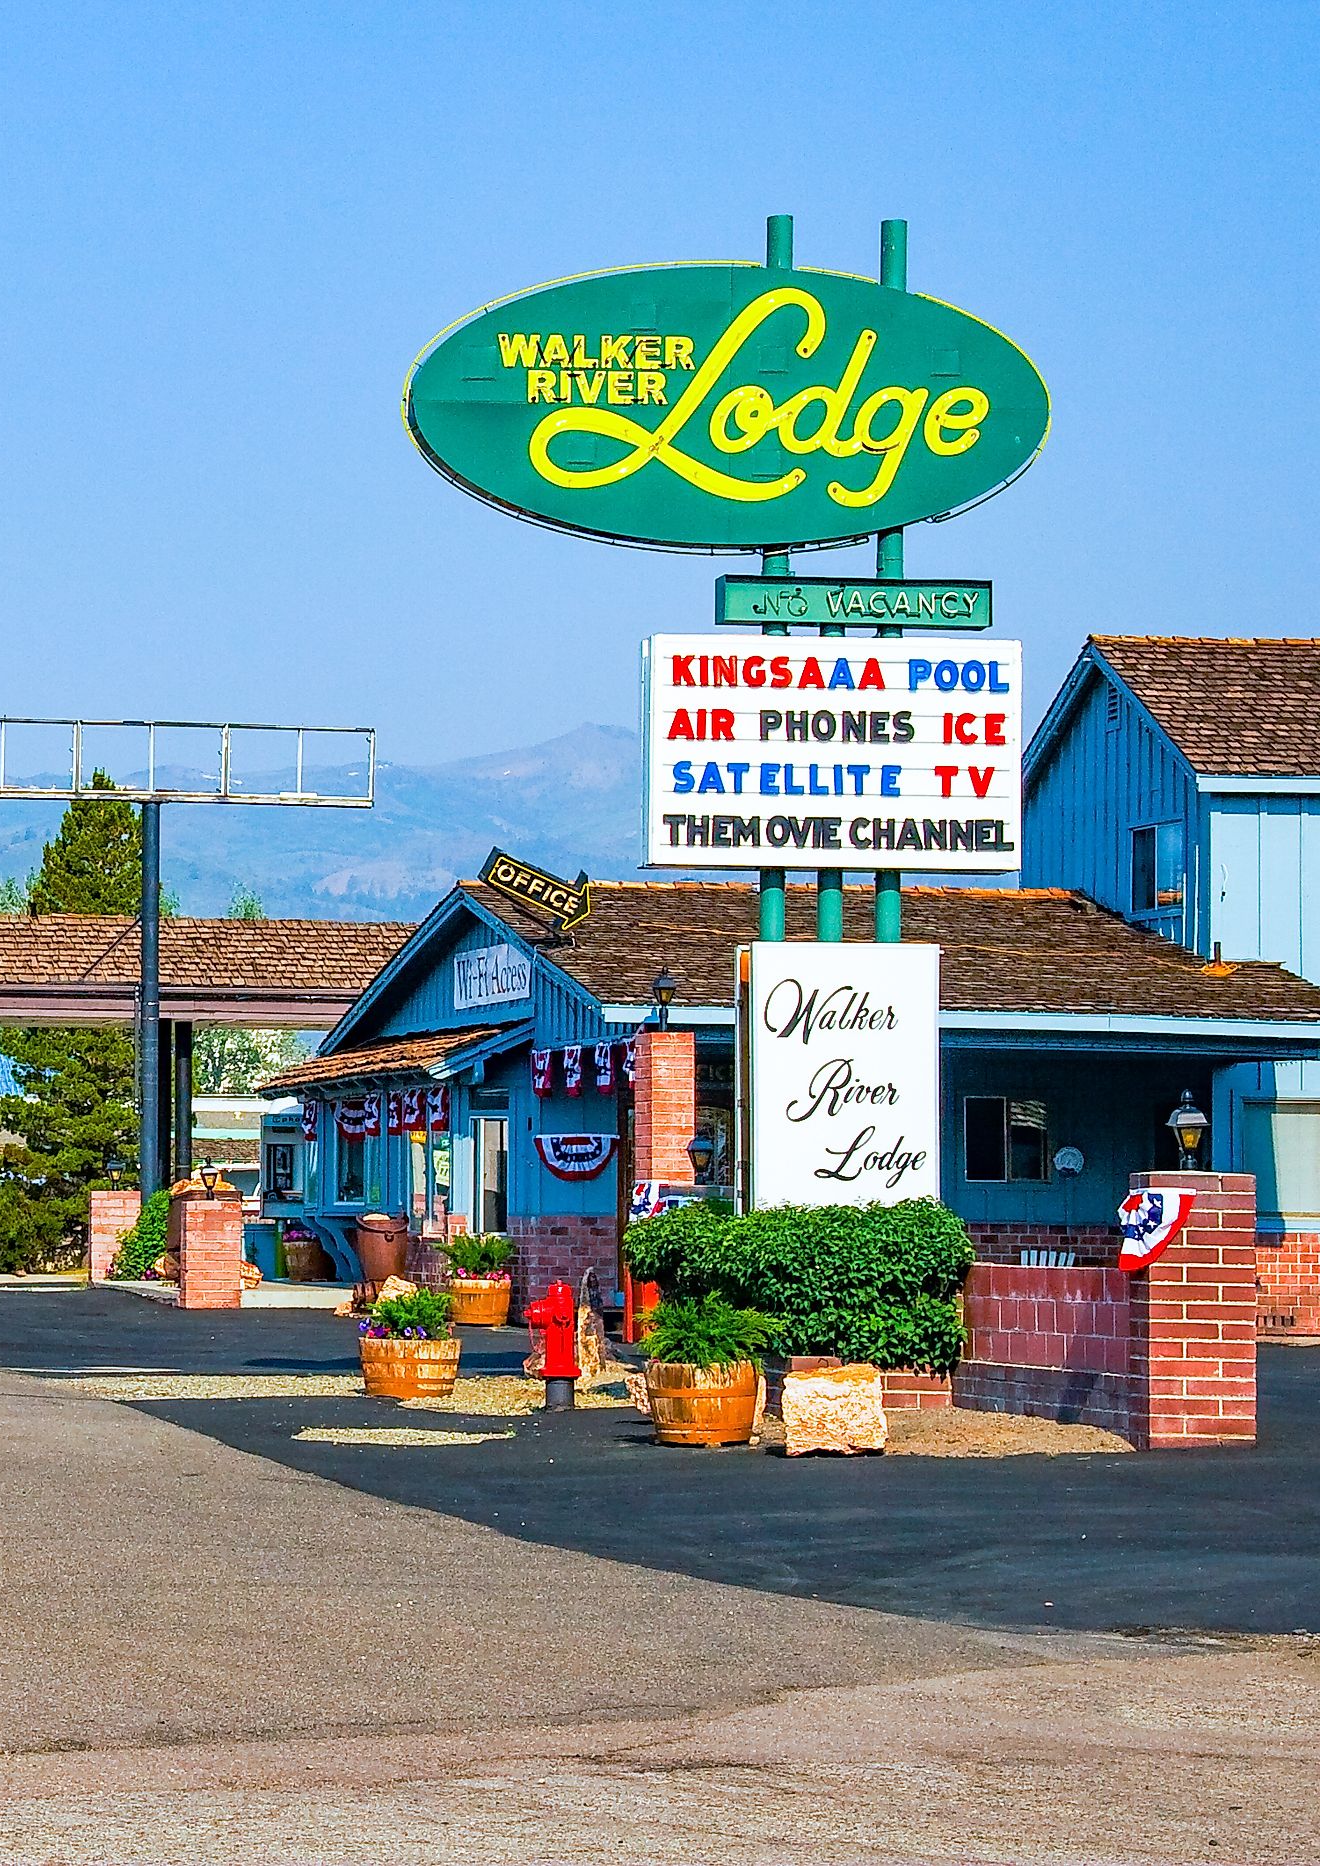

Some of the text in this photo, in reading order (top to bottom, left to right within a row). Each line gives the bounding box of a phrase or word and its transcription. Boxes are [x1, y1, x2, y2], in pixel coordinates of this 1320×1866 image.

[498, 332, 695, 371] WALKER
[528, 369, 669, 404] RIVER
[530, 287, 989, 508] Lodge
[753, 588, 980, 619] NO VACANCY
[908, 659, 1010, 693] POOL
[667, 708, 1006, 746] AIR PHONES ICE
[672, 760, 995, 798] SATELLITE TV
[848, 818, 1015, 852] CHANNEL
[496, 863, 580, 916] OFFICE
[457, 954, 528, 1001] Wi-Fi Access
[764, 978, 898, 1045] Walker
[786, 1058, 900, 1122] River
[813, 1125, 927, 1189] Lodge
